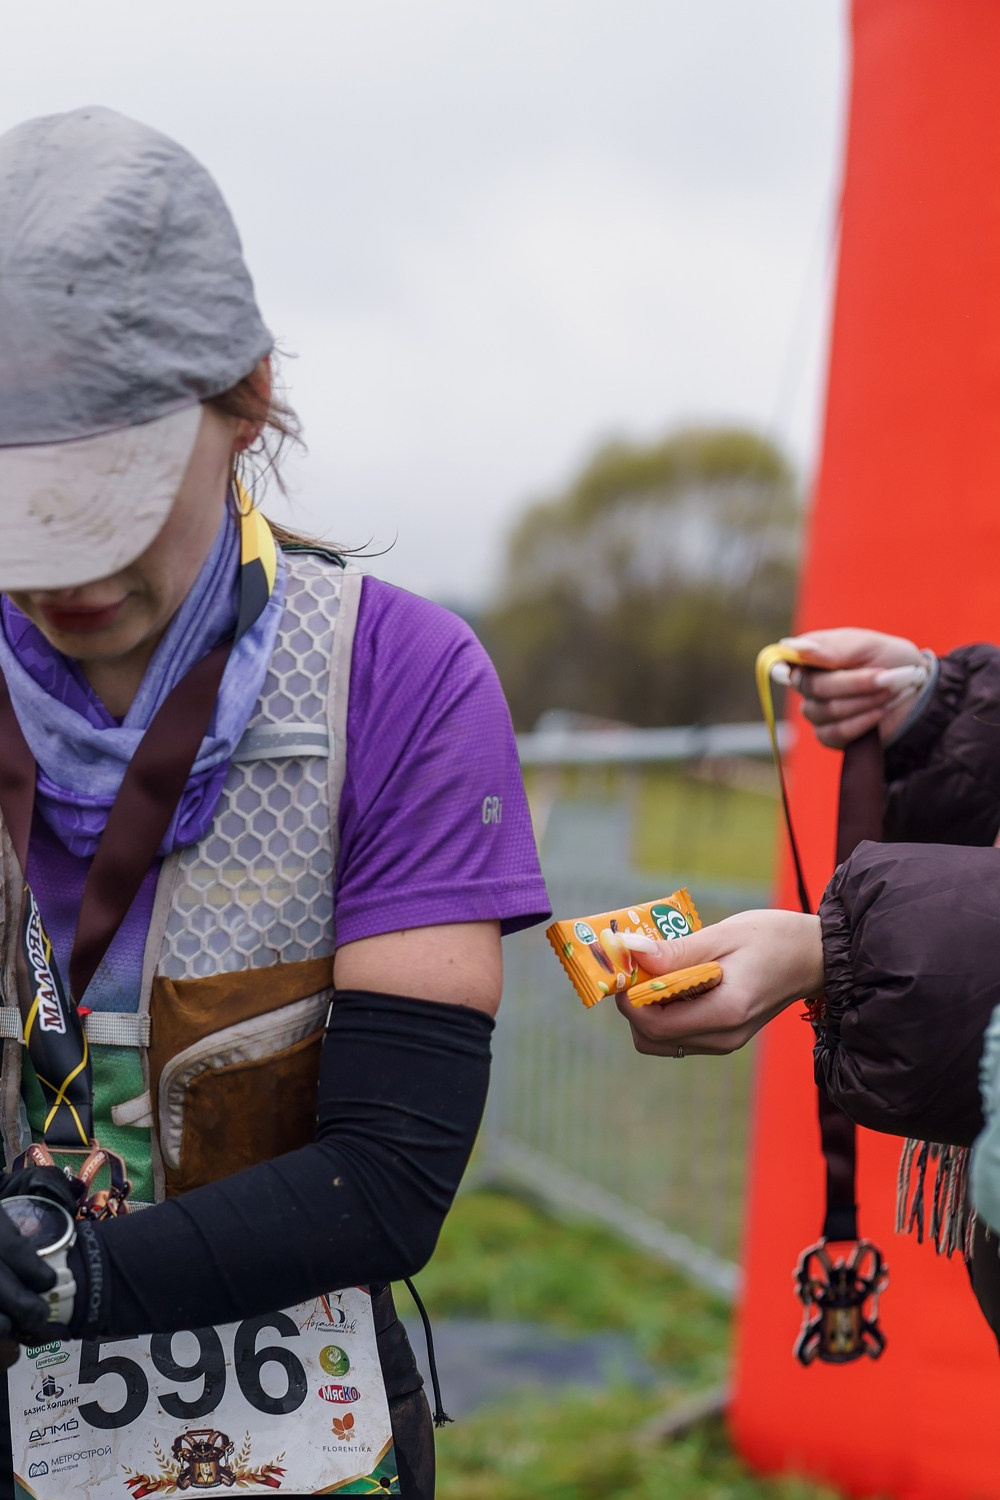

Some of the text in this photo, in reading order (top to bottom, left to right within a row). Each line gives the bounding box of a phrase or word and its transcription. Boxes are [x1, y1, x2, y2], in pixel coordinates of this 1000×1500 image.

[78, 1311, 308, 1430] 596
[23, 1396, 80, 1416] БАЗИС ХОЛДИНГ
[51, 1445, 112, 1466] МЕТРОСТРОЙ
[322, 1445, 372, 1453] FLORENTIKA
